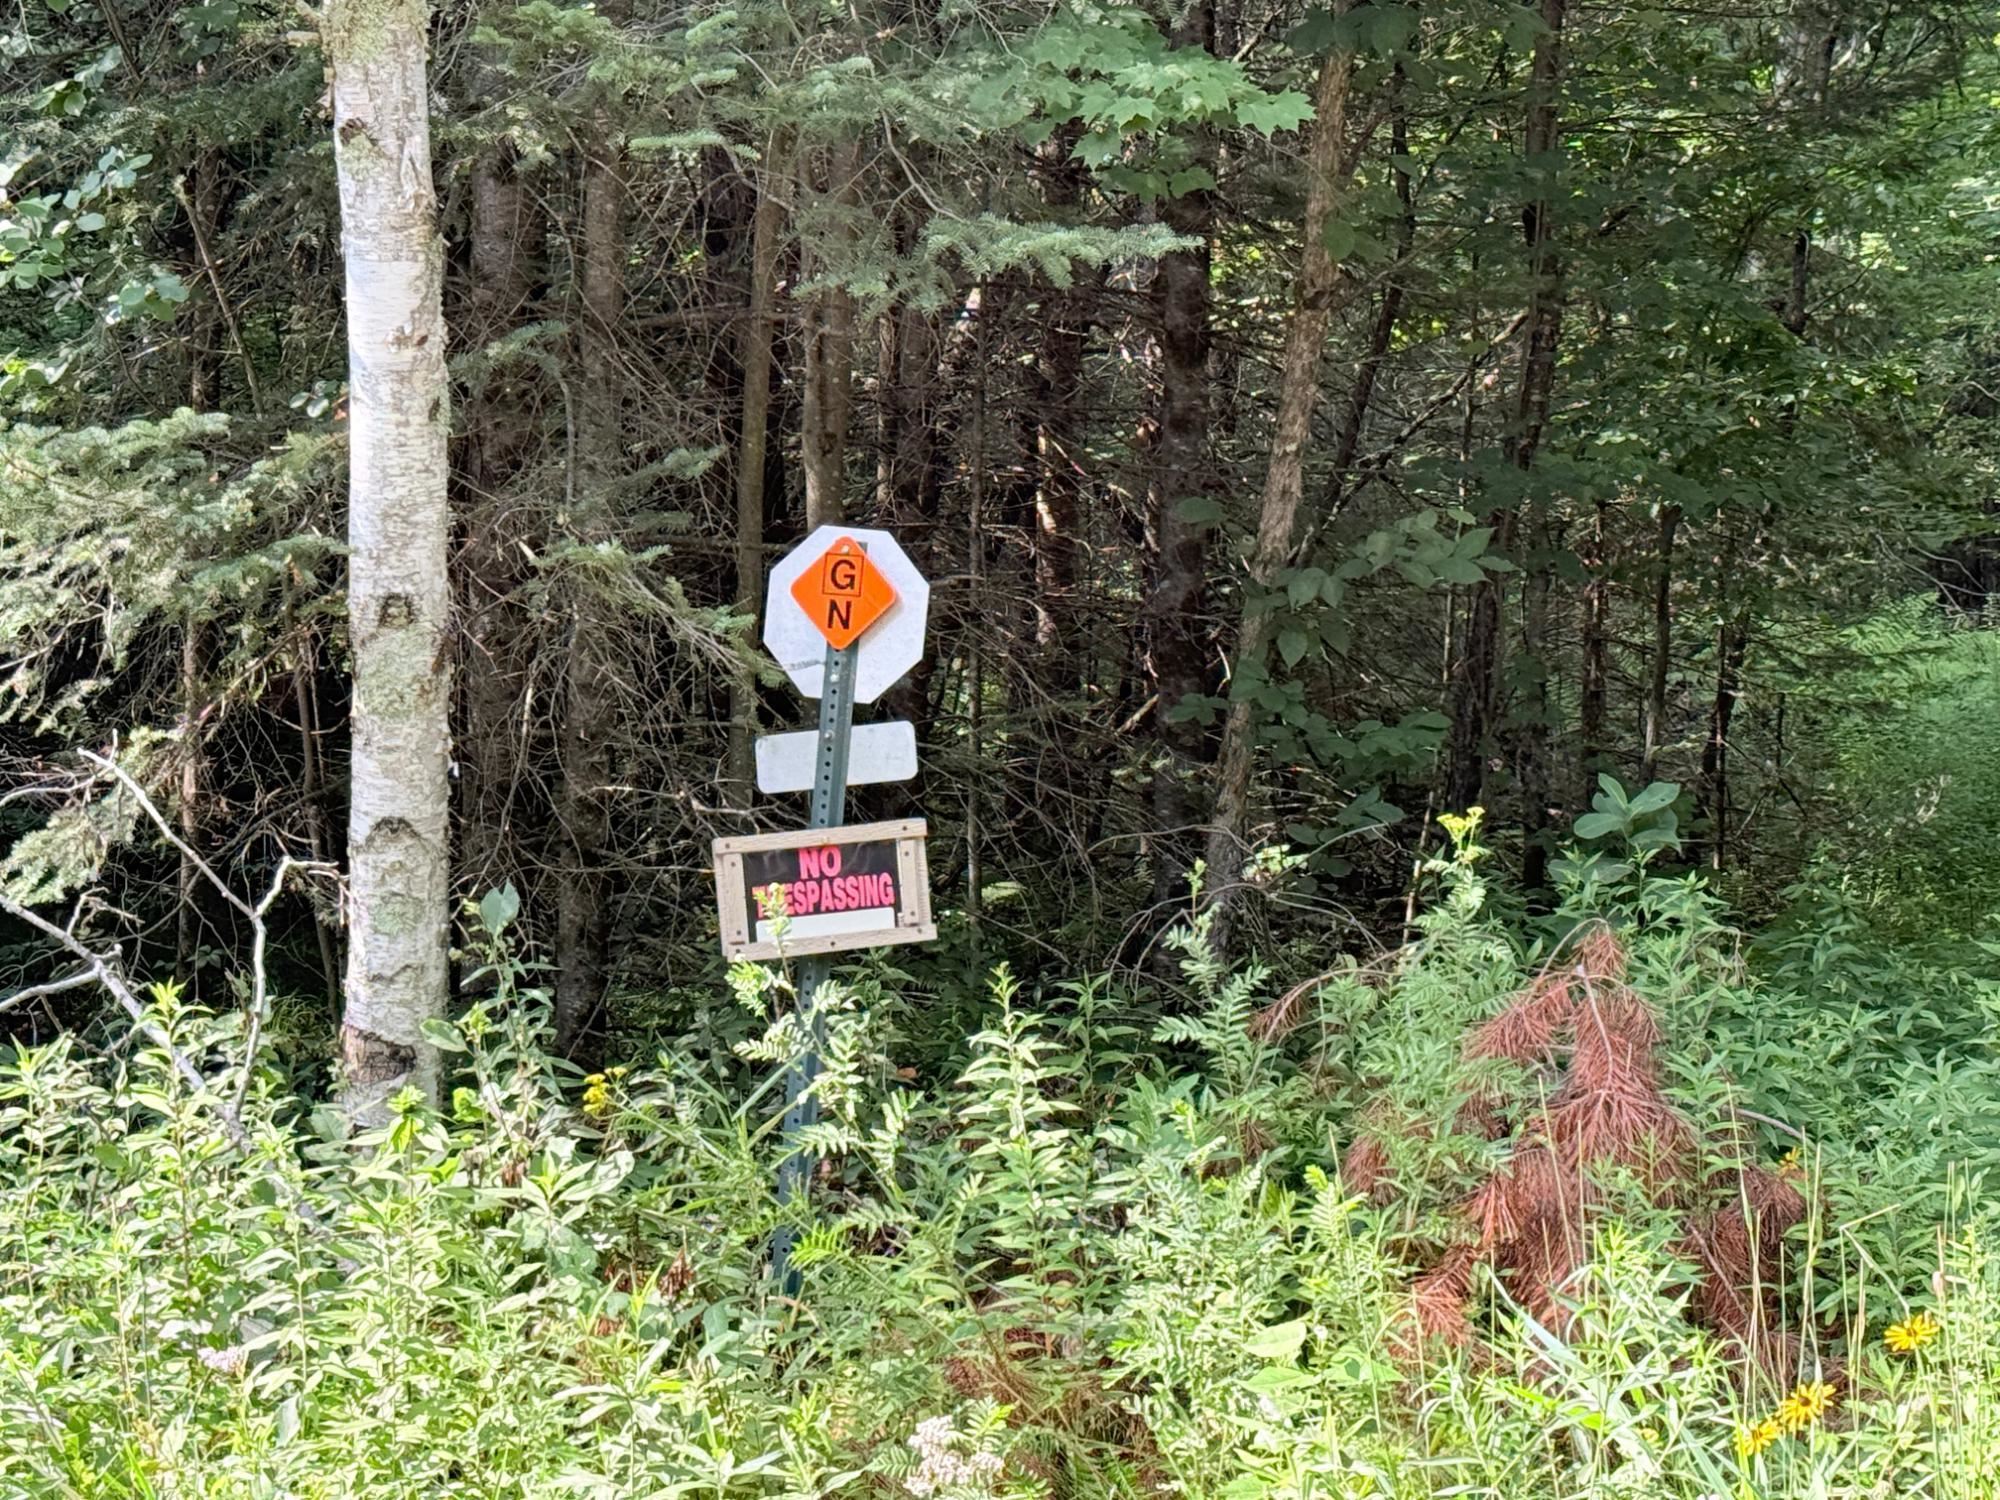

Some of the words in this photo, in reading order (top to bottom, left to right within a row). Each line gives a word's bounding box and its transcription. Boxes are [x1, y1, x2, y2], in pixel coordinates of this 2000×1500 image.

[830, 559, 856, 590] G
[827, 598, 852, 630] N
[798, 844, 842, 879] NO
[752, 872, 895, 918] TESPASSING
